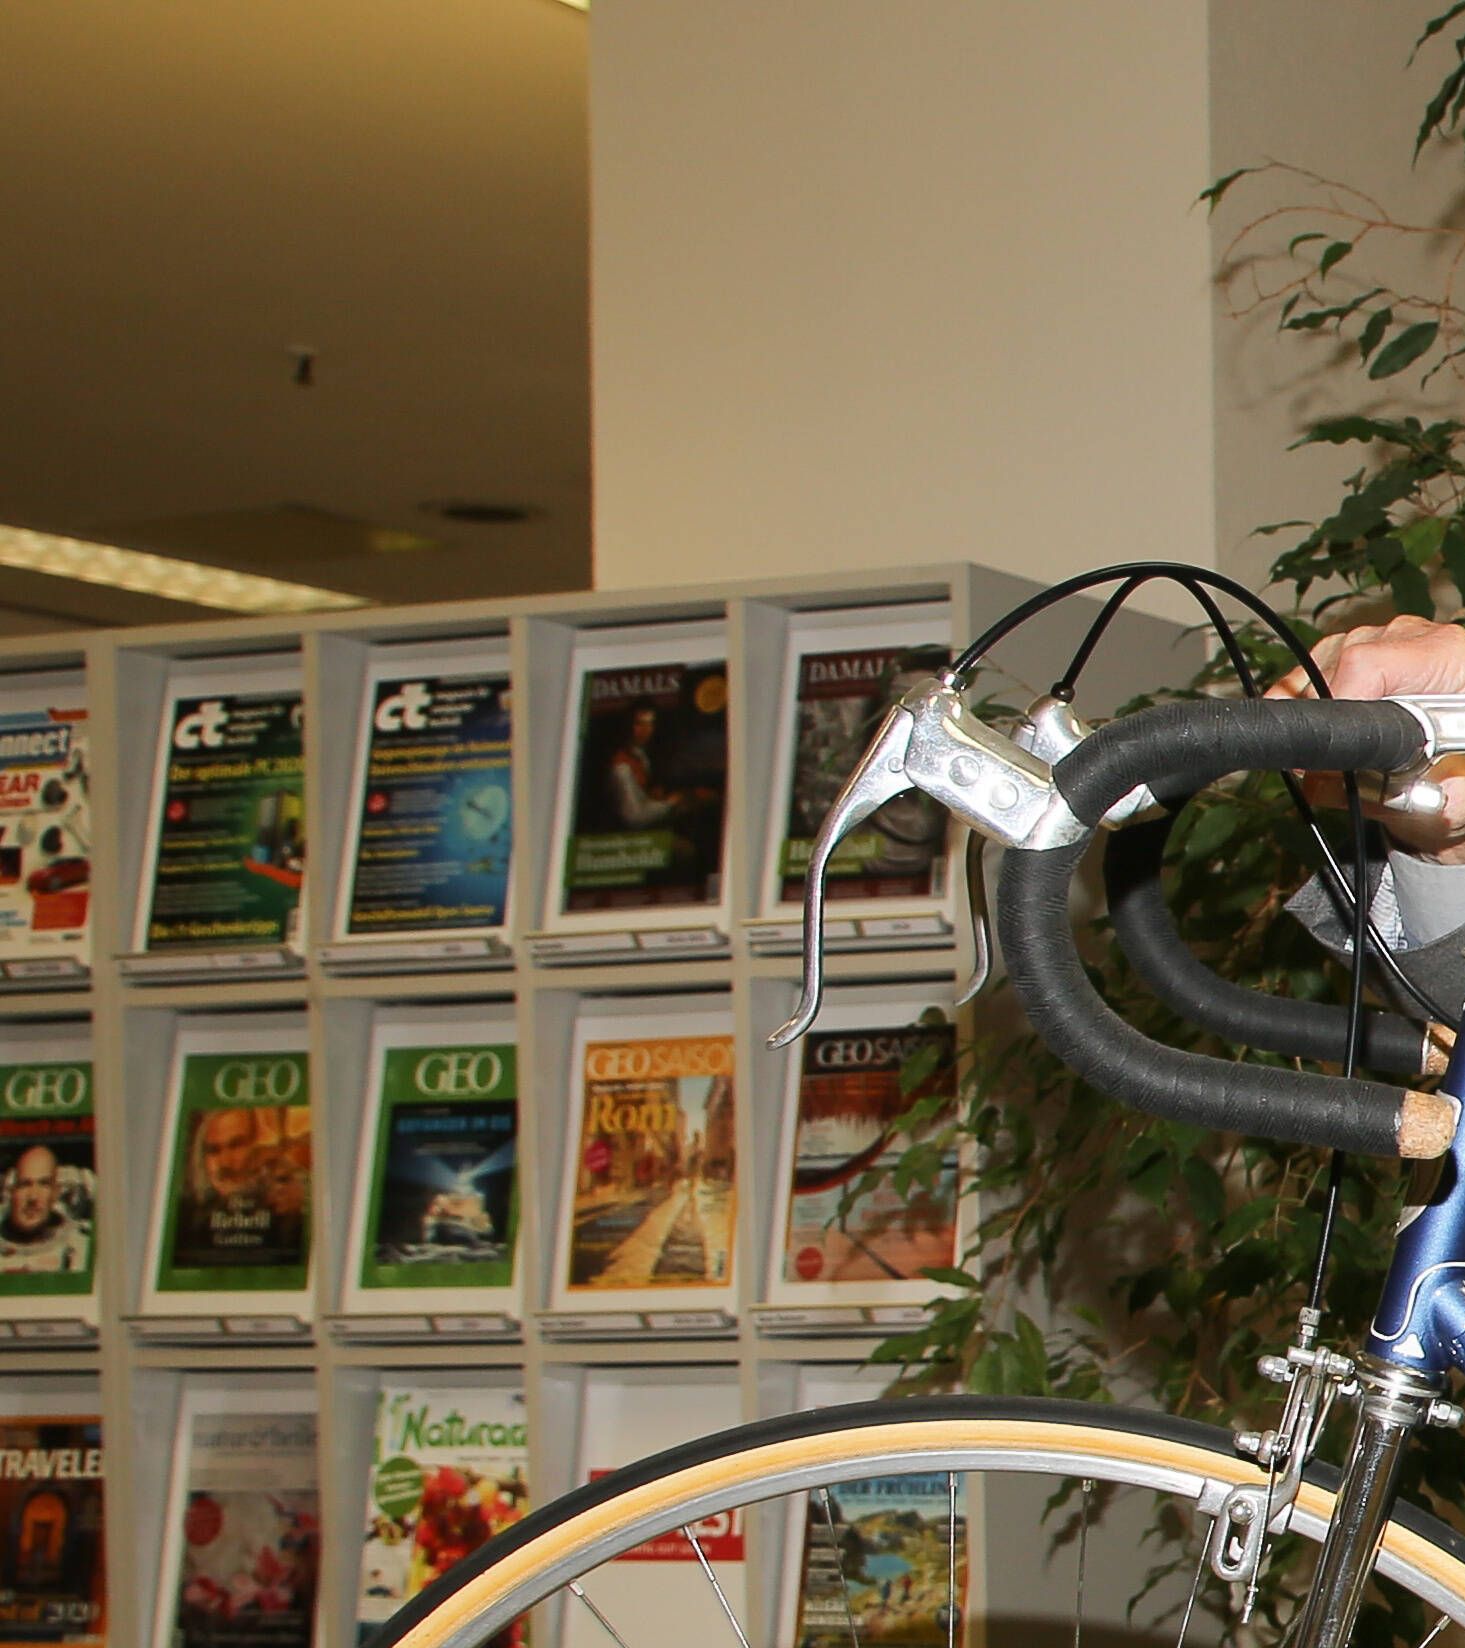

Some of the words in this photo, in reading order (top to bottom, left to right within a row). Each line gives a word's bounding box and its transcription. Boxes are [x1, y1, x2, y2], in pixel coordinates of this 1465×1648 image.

[592, 672, 681, 699] DAMALS
[214, 1058, 301, 1104] GEO
[415, 1051, 502, 1097] GEO
[587, 1047, 650, 1081] GEO
[5, 1067, 87, 1110] GEO
[589, 1093, 678, 1134] Rom
